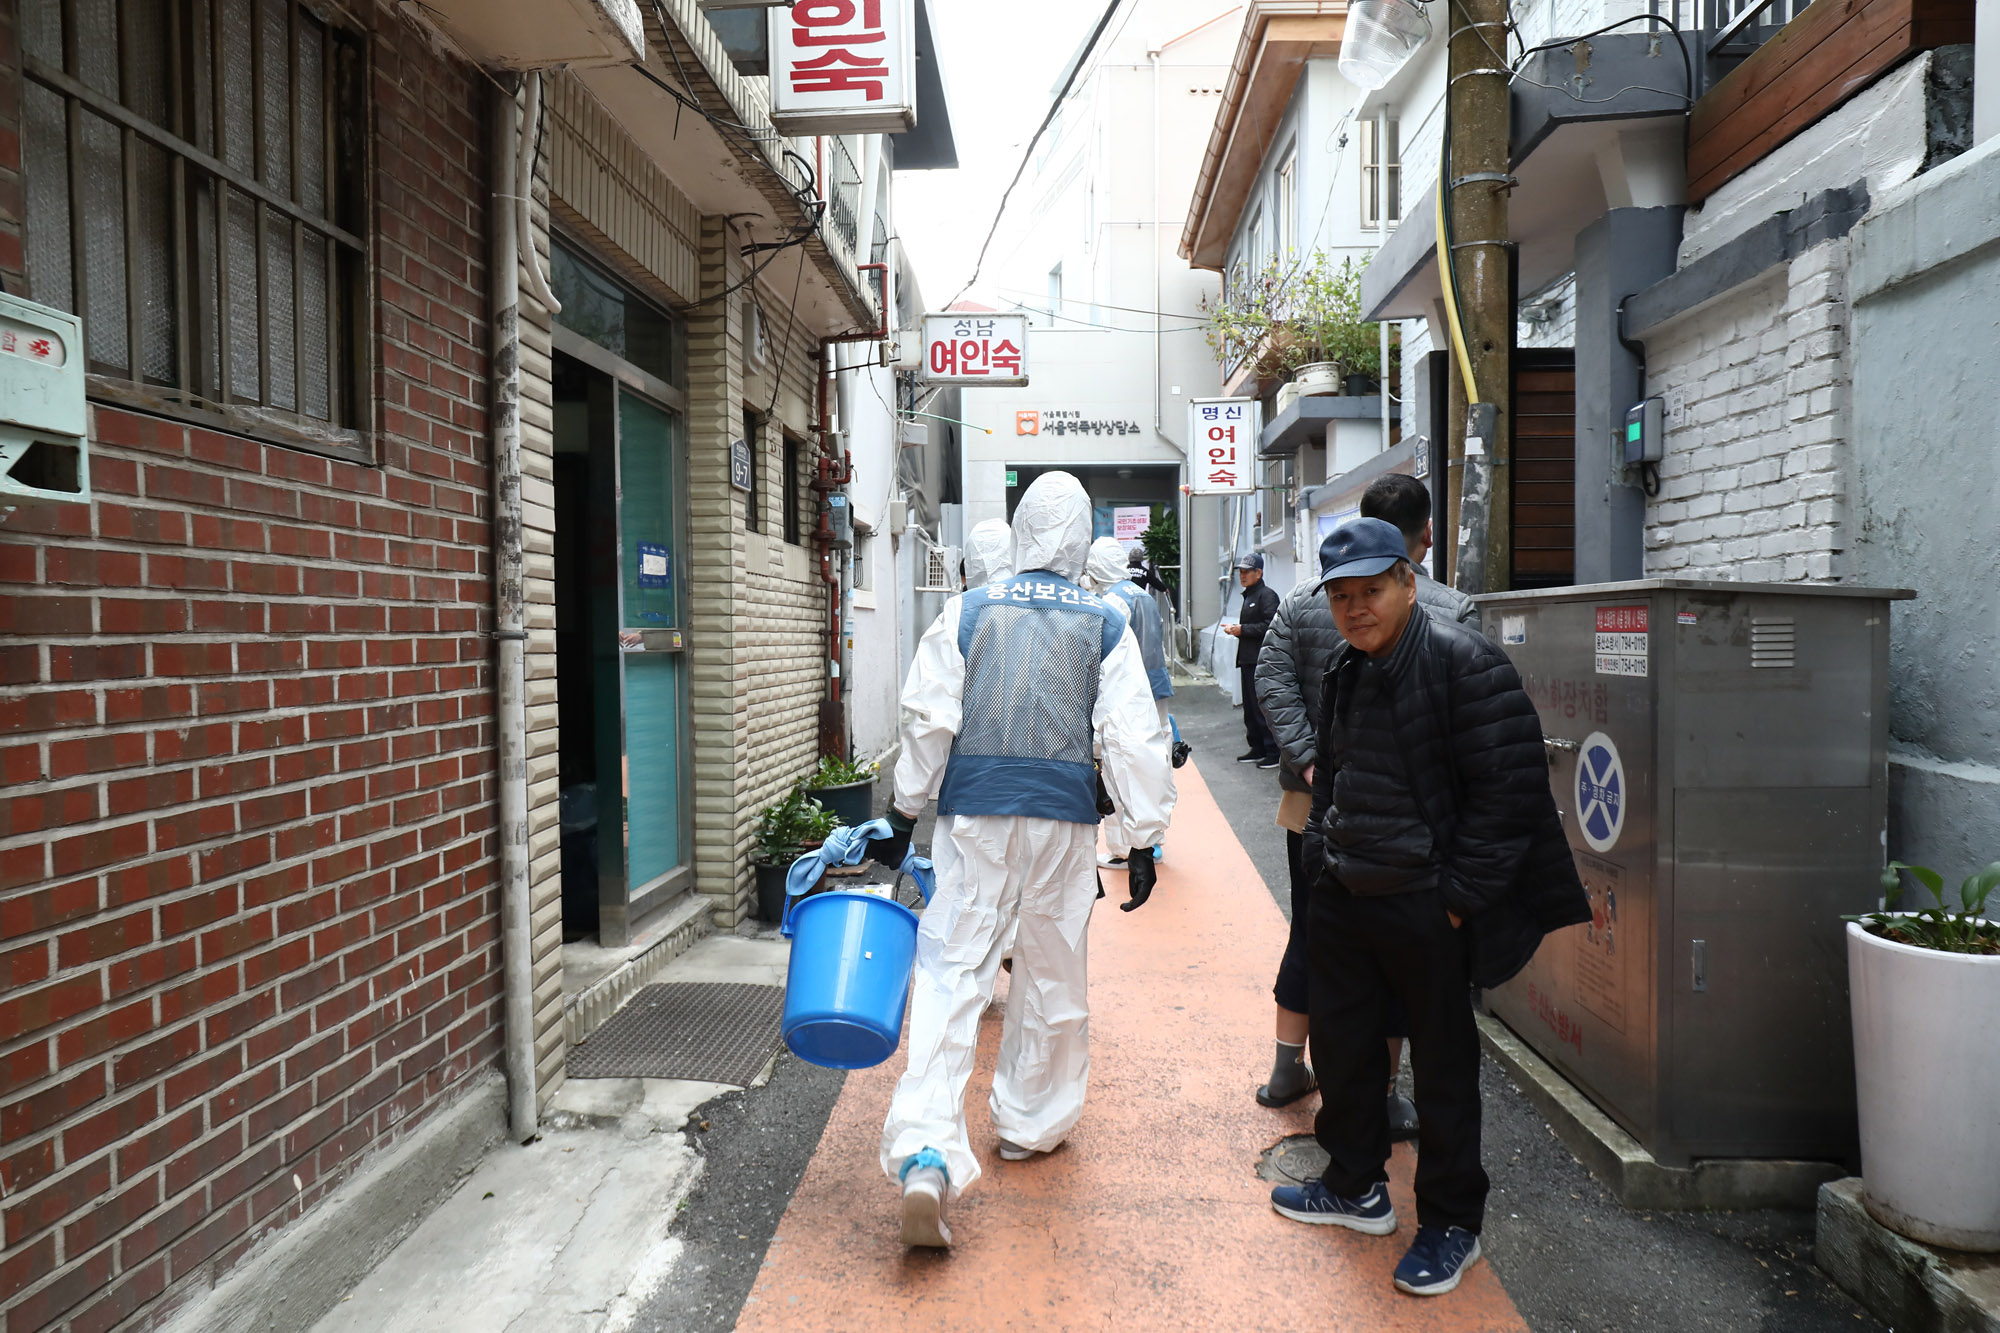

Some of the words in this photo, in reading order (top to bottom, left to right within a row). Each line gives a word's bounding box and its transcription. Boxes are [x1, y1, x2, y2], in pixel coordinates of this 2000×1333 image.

[953, 320, 996, 337] 성남
[930, 339, 1021, 376] 여인숙
[1042, 410, 1081, 419] 서울특별시립
[1202, 406, 1241, 420] 명신
[1042, 420, 1141, 436] 서울역쪽방상담소
[1208, 425, 1238, 486] 여인숙
[735, 462, 748, 484] 9-7
[1417, 455, 1427, 474] 9-8
[985, 581, 1104, 609] 용산보건소
[1597, 635, 1619, 650] 용산소방서
[1621, 636, 1646, 651] 794-0119
[1621, 658, 1646, 673] 754-0119
